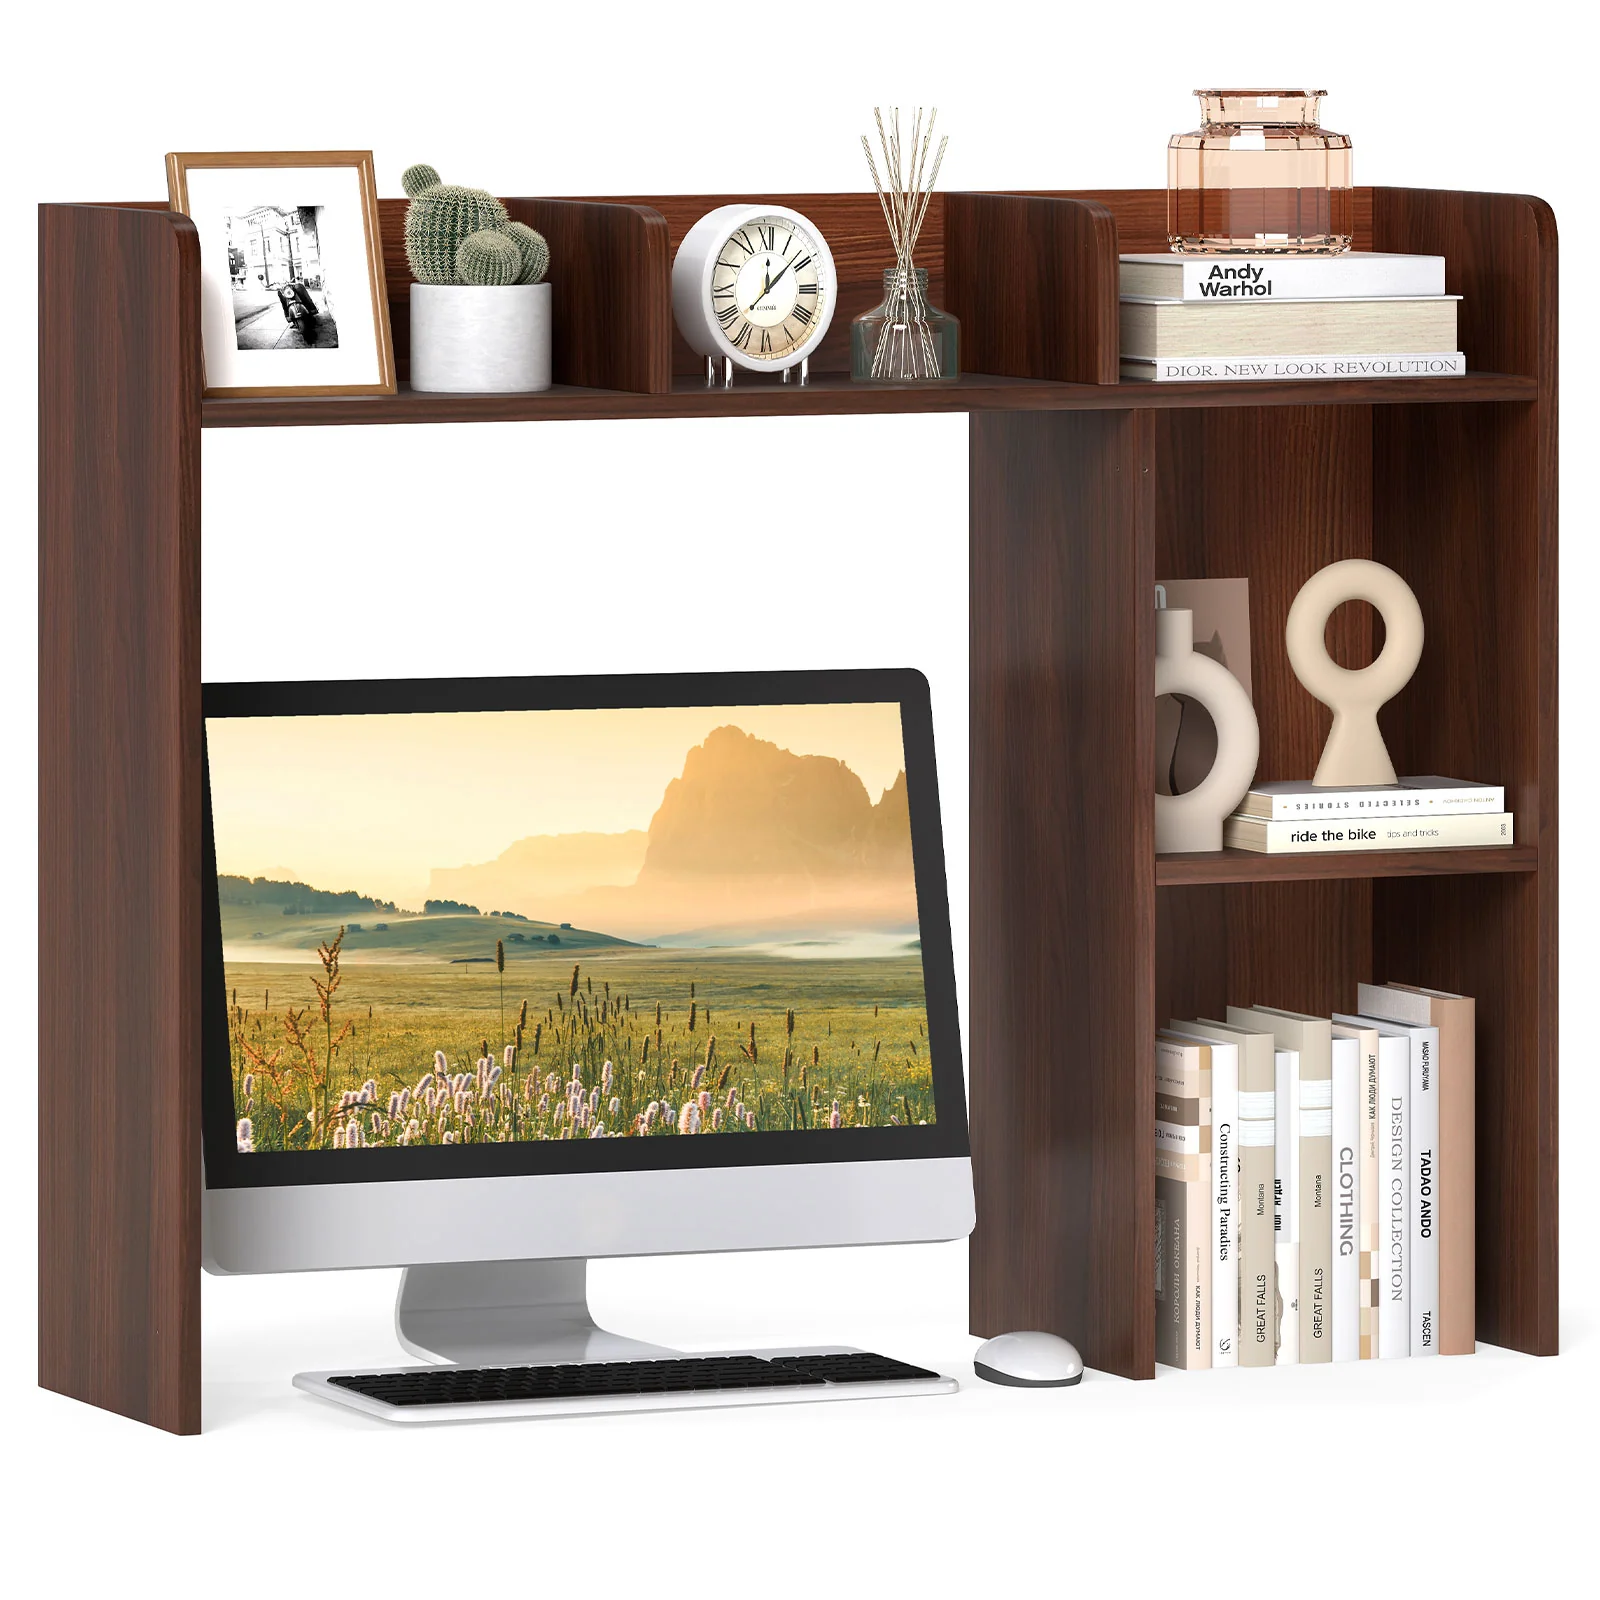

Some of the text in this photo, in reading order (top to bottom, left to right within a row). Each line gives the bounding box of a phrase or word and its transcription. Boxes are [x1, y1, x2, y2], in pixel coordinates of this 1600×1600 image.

[1199, 280, 1272, 297] Warhol
[1208, 263, 1264, 284] Andy
[1166, 360, 1458, 377] DIOR. NEW LOOK REVOLUTION
[1296, 799, 1420, 810] SELECTED STORIES
[1291, 831, 1318, 842] ride
[1322, 830, 1344, 841] the
[1348, 828, 1376, 840] bike
[1402, 829, 1418, 837] and
[1419, 829, 1439, 837] tricks
[1217, 1123, 1230, 1261] Constructing Paradies
[1340, 1147, 1353, 1256] CLOTHING
[1391, 1097, 1402, 1301] DESIGN COLLECTION
[1421, 1149, 1431, 1238] TADAO ANDO
[1257, 1274, 1266, 1305] FALLS
[1314, 1268, 1323, 1300] FALLS
[1257, 1309, 1266, 1342] GREAT
[1313, 1303, 1322, 1338] GREAT
[1422, 1311, 1431, 1347] TASCEN
